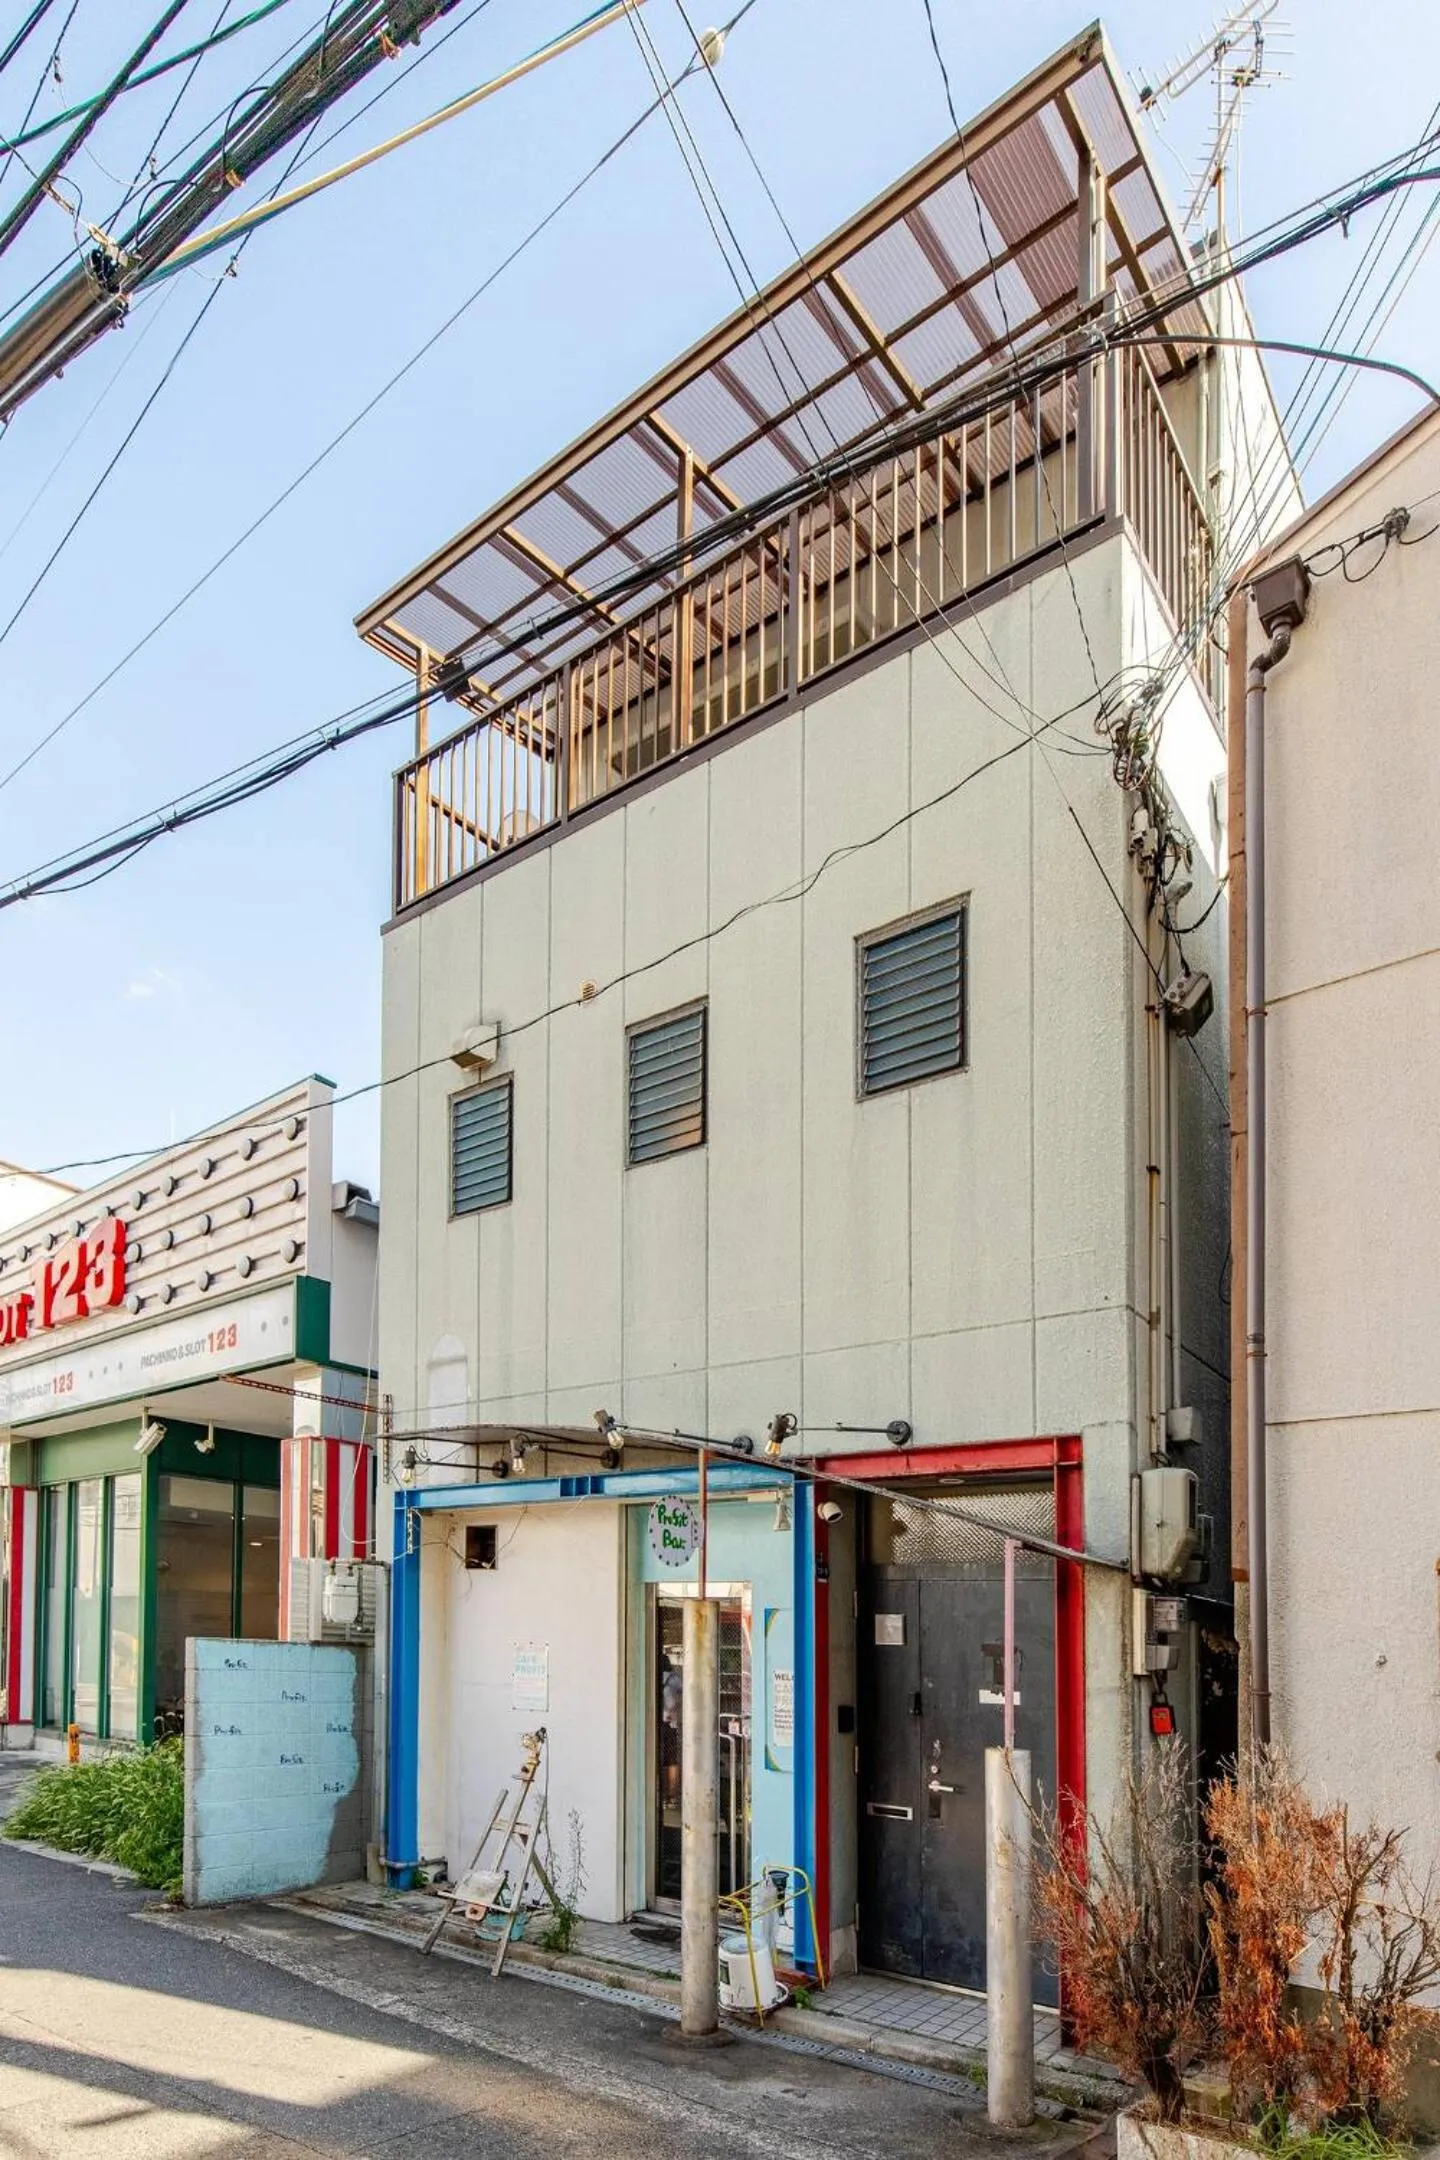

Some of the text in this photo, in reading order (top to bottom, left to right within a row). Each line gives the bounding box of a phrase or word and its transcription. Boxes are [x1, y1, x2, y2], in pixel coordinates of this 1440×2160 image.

[32, 1216, 126, 1329] 123
[208, 1323, 238, 1353] 123
[53, 1371, 74, 1394] 123
[657, 1503, 689, 1528] Profit
